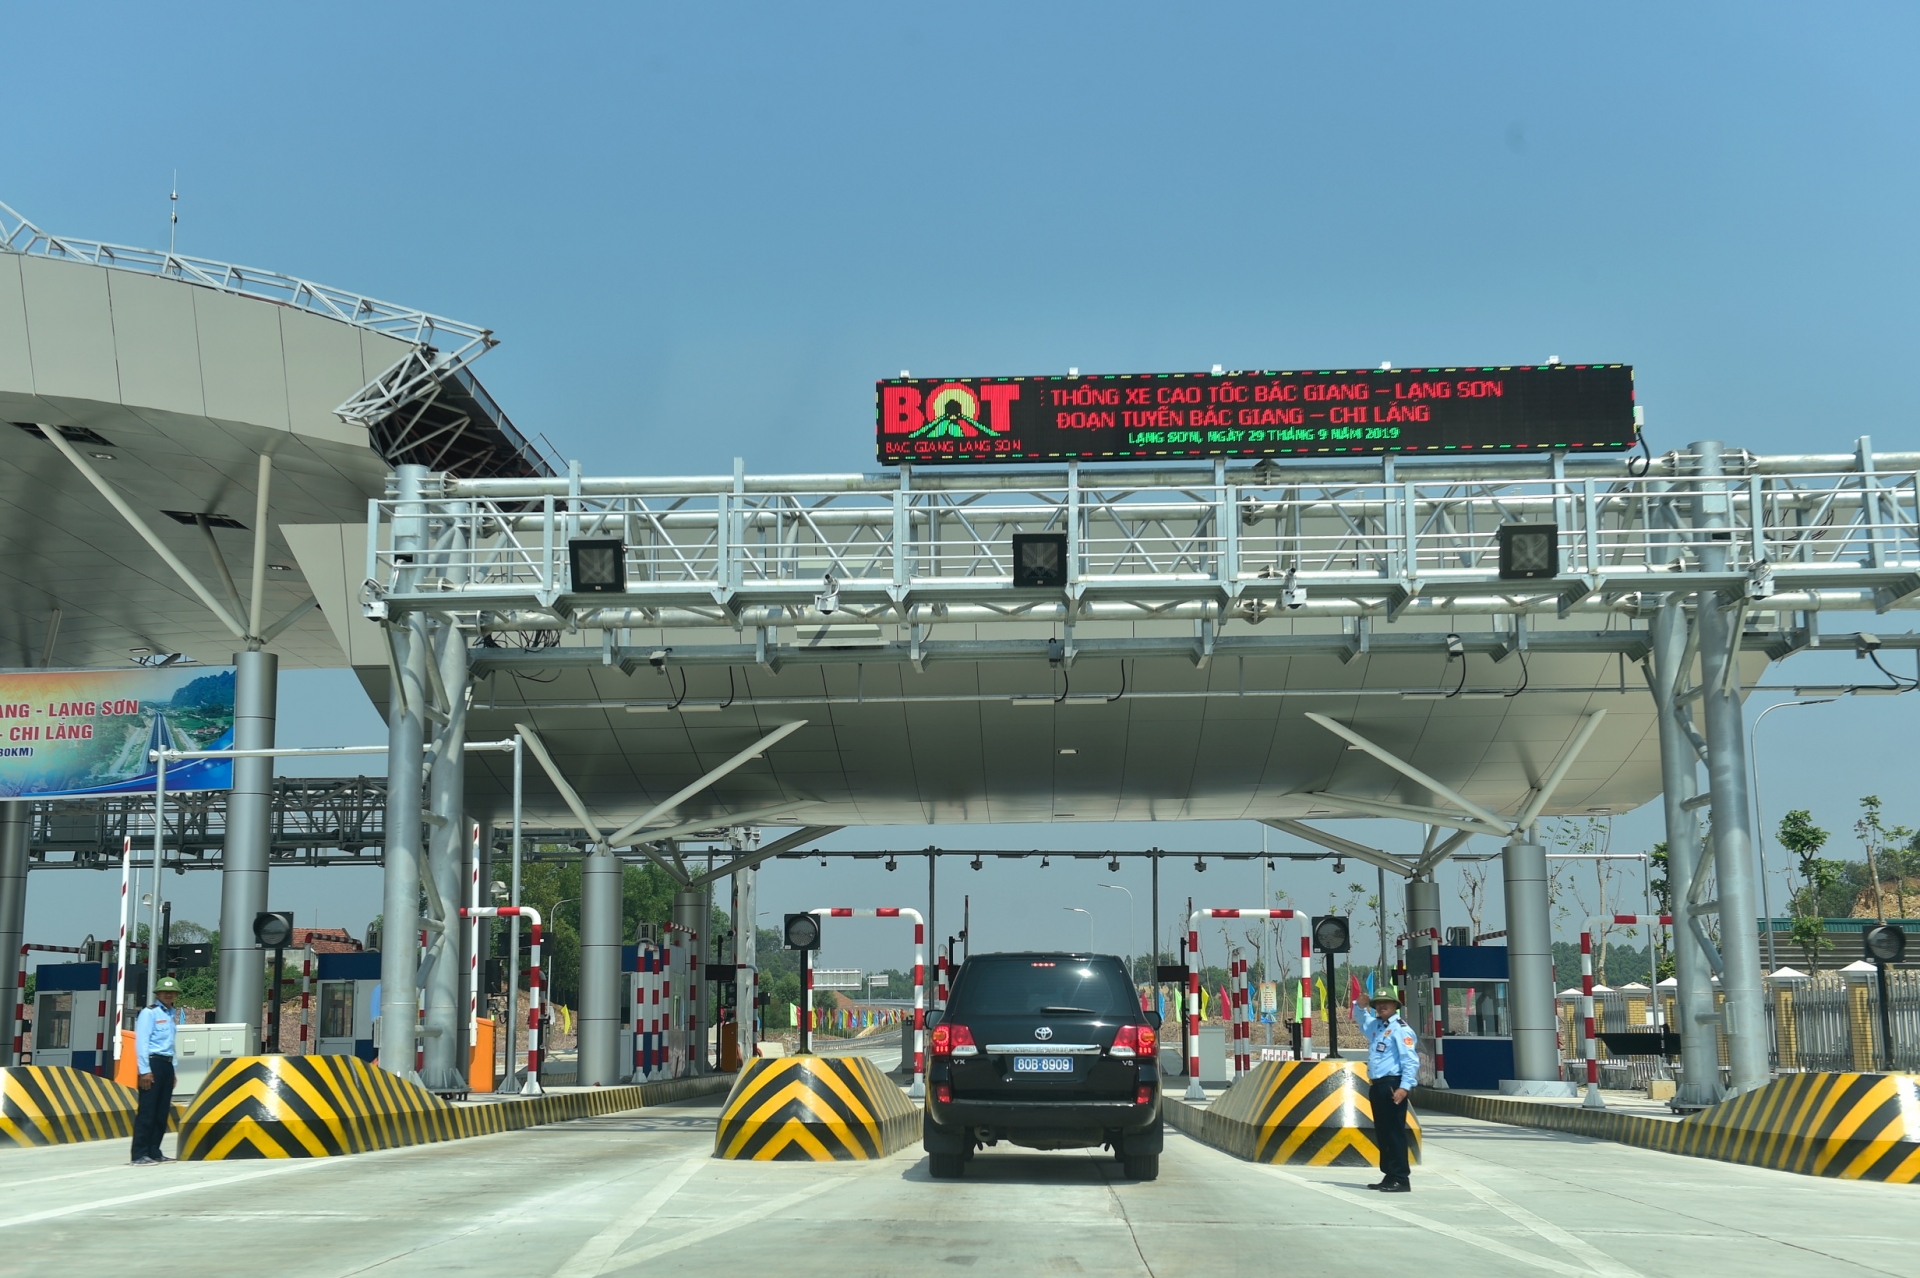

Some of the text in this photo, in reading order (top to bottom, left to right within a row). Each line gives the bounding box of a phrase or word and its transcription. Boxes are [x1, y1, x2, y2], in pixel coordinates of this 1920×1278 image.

[1050, 384, 1120, 406] THÔNG
[1125, 387, 1152, 405] XE
[1157, 386, 1202, 404] CAO
[1208, 381, 1250, 403] TỐC
[1254, 380, 1299, 402] BẮC
[1303, 383, 1370, 401] GIANG
[1395, 381, 1452, 402] LẠNG
[884, 382, 1020, 438] BOT
[1056, 410, 1116, 432] ĐOẠN
[1121, 405, 1185, 428] TUYẾN
[1189, 404, 1234, 427] BẮC
[1238, 407, 1305, 426] GIANG
[1329, 405, 1369, 424] CHI
[1373, 401, 1431, 423] LĂNG
[1247, 429, 1267, 442] 29
[1317, 428, 1329, 441] 9
[1364, 427, 1401, 439] 2019
[914, 440, 954, 453] GIANG
[48, 701, 96, 720] LẠNG
[101, 699, 138, 716] SƠN
[9, 722, 93, 741] CHI LĂNG
[953, 1058, 966, 1066] VX
